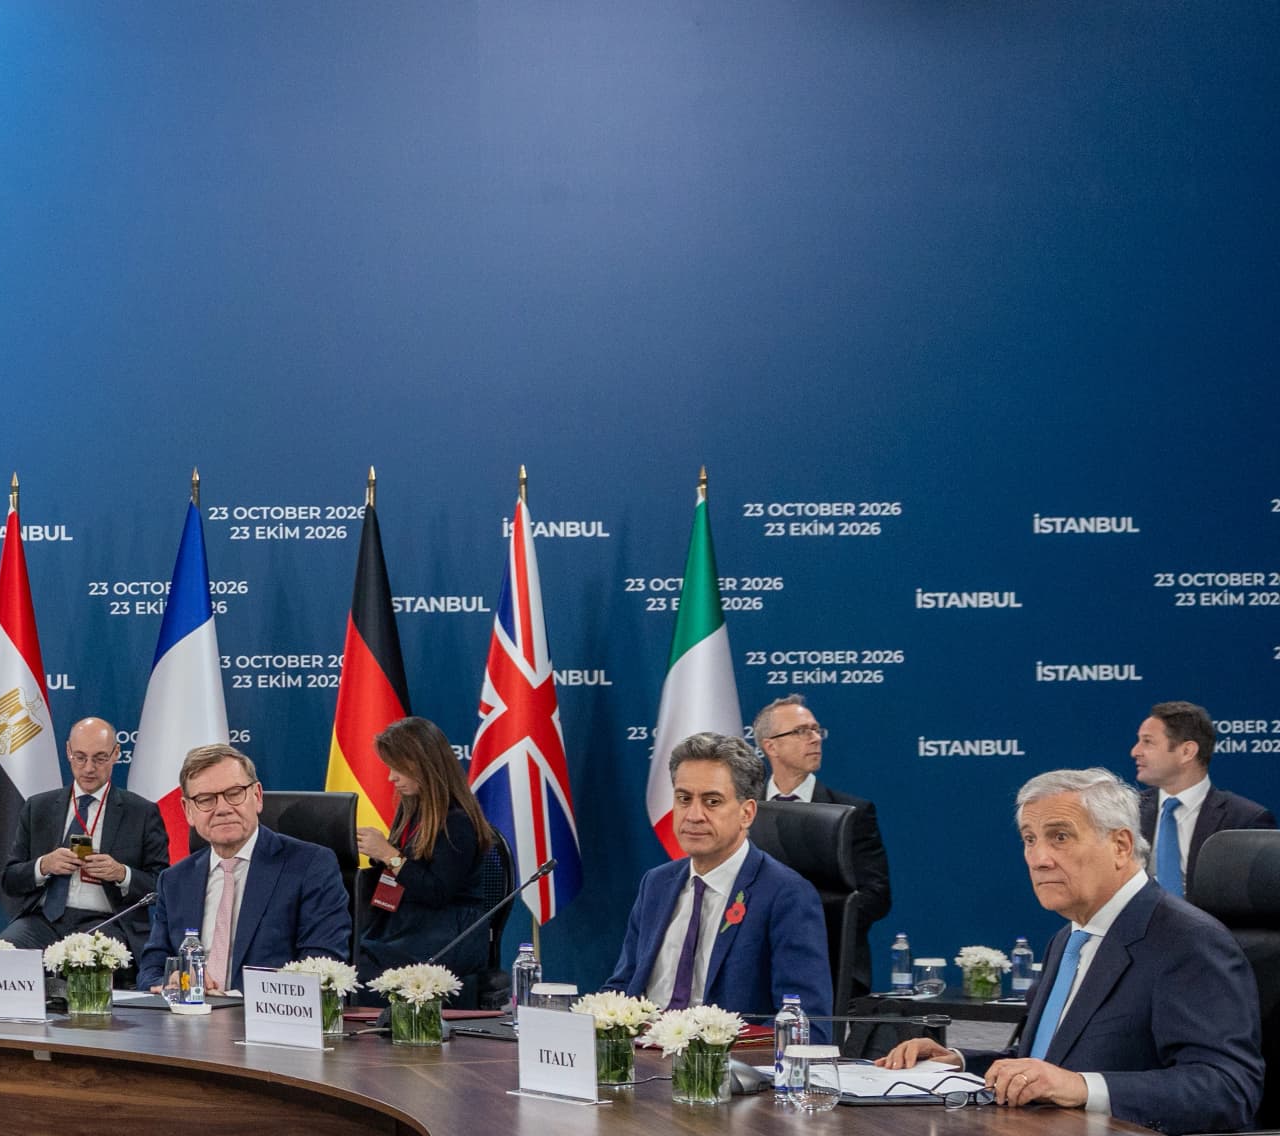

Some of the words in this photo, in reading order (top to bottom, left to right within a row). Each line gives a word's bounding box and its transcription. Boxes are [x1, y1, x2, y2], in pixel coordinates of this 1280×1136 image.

[209, 507, 228, 519] 23
[234, 507, 320, 519] OCTOBER
[326, 506, 366, 519] 2026
[744, 504, 764, 516] 23
[768, 503, 855, 516] OCTOBER
[859, 502, 901, 515] 2026
[230, 527, 250, 539] 23
[256, 523, 299, 539] EKİM
[305, 526, 347, 539] 2026
[765, 523, 785, 536] 23
[790, 520, 834, 536] EKİM
[839, 522, 881, 535] 2026
[1034, 514, 1139, 533] İSTANBUL
[625, 578, 645, 591] 23
[649, 578, 737, 591] OCTER
[741, 577, 783, 590] 2026
[1154, 573, 1174, 586] 23
[1178, 573, 1265, 586] OCTOBER
[89, 583, 108, 595] 23
[209, 581, 248, 594] 2026
[392, 597, 490, 612] STANBUL
[646, 598, 666, 611] 23
[721, 597, 763, 610] 2026
[916, 588, 1022, 608] İSTANBUL
[1176, 593, 1196, 606] 23
[1200, 590, 1244, 606] EKİM
[1249, 592, 1280, 605] 202
[110, 602, 130, 614] 23
[136, 598, 167, 614] EKİ
[236, 655, 323, 668] OCTOBER
[746, 652, 766, 664] 23
[771, 651, 858, 664] OCTOBER
[862, 650, 904, 663] 2026
[553, 670, 612, 686] NBUL
[768, 671, 788, 684] 23
[792, 668, 836, 684] EKİM
[841, 670, 883, 683] 2026
[1037, 661, 1142, 681] İSTANBUL
[233, 675, 252, 688] 23
[258, 672, 301, 688] EKİM
[628, 727, 648, 740] 23
[1213, 720, 1267, 733] TOBER
[919, 736, 1025, 756] İSTANBUL
[1213, 737, 1246, 752] KİM
[1251, 740, 1280, 752] 202
[261, 982, 305, 996] UNITED
[255, 1002, 313, 1018] KINGDOM
[539, 1049, 577, 1067] ITALY
